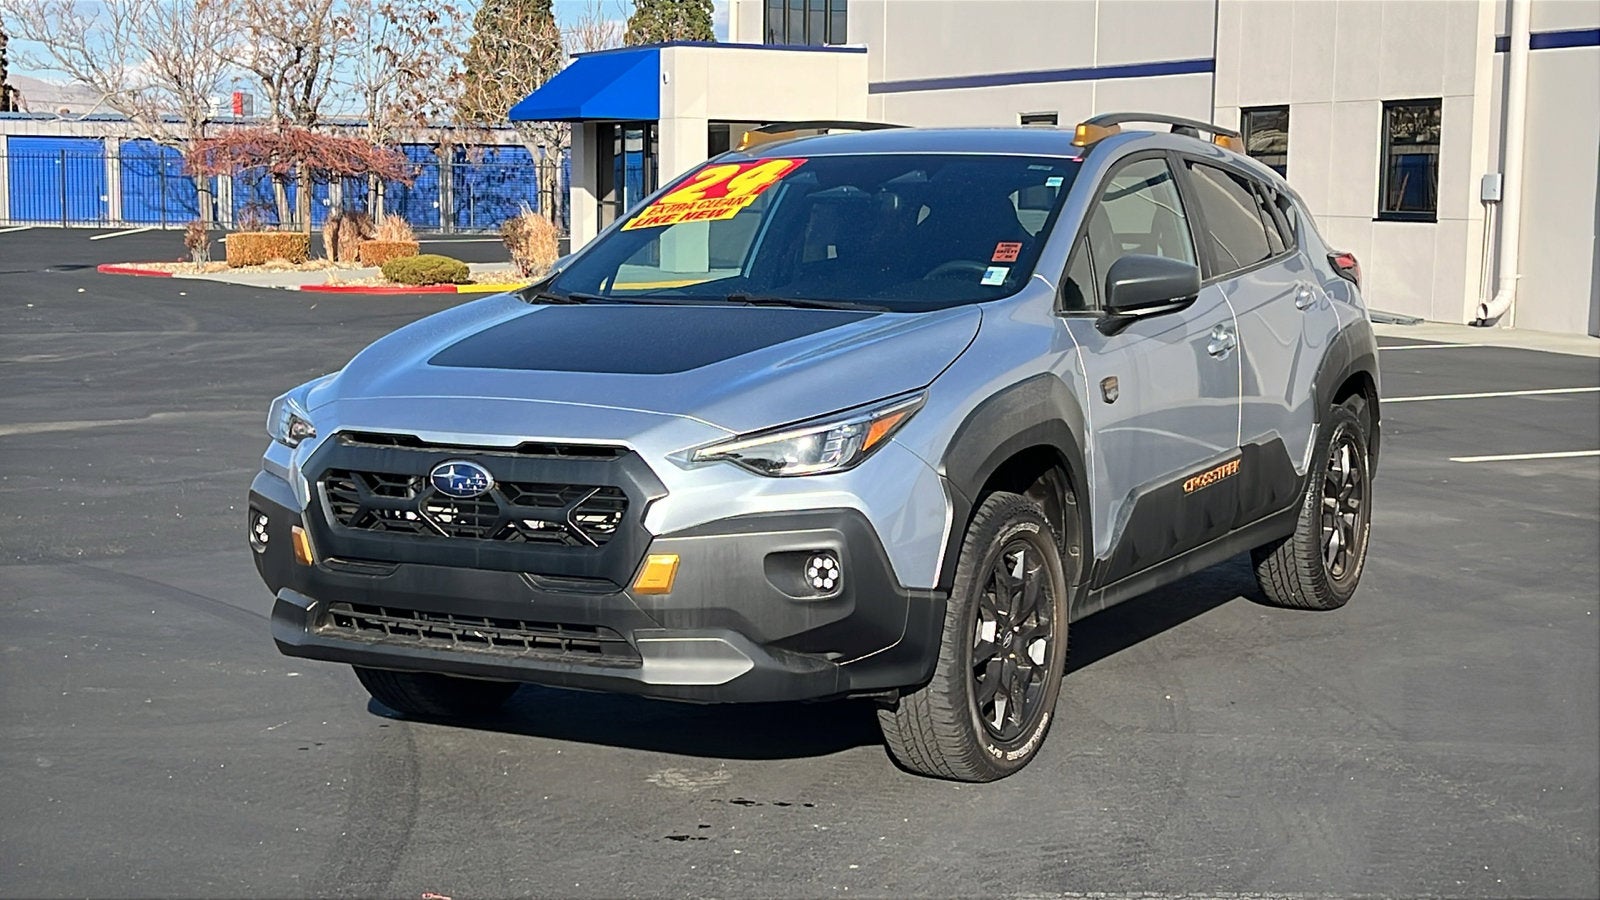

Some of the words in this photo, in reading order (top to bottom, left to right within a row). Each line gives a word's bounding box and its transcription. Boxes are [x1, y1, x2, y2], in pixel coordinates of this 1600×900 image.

[657, 159, 794, 204] 24
[647, 200, 694, 216] EXTRA
[695, 197, 748, 210] CLEAN
[630, 213, 678, 228] LIKE
[681, 208, 731, 221] NEW
